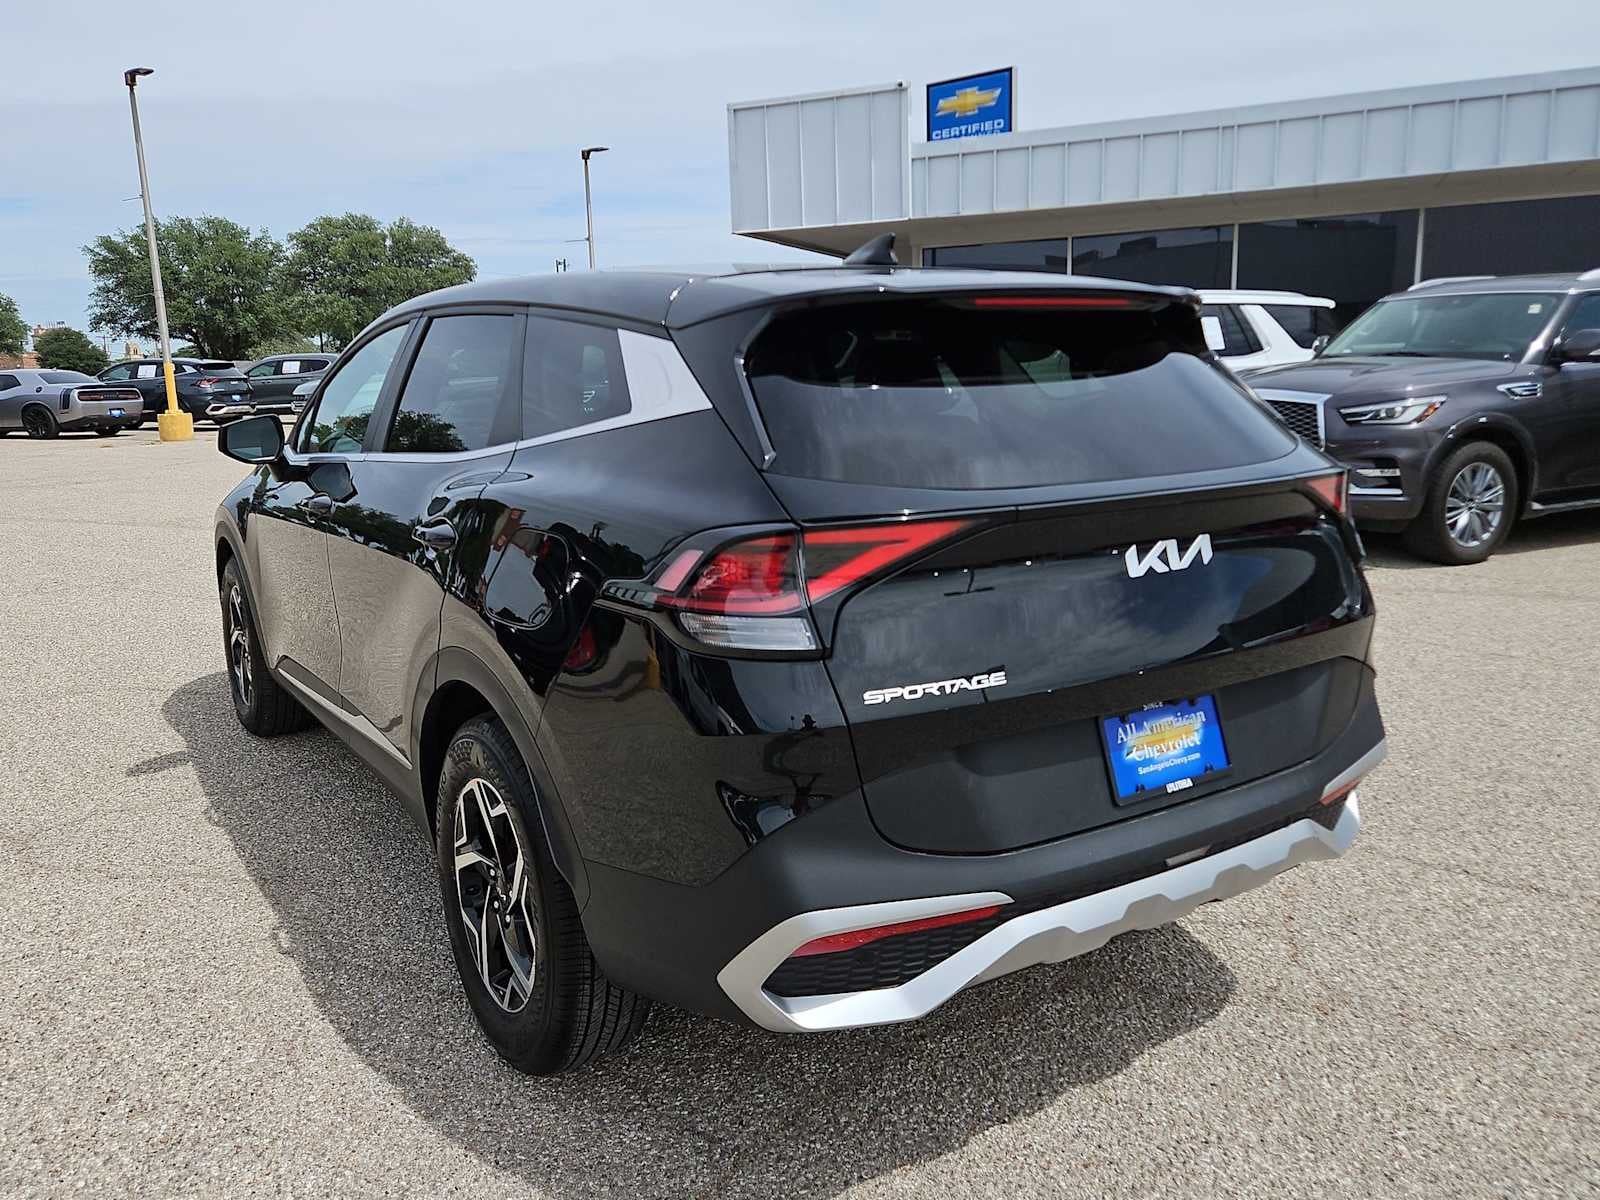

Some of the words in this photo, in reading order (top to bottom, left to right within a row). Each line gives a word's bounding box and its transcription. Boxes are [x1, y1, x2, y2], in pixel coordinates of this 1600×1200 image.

[932, 119, 1004, 140] CERTIFIED
[1125, 533, 1213, 578] KIA
[863, 671, 1008, 705] SPORTAGE
[1117, 721, 1136, 744] All
[1142, 710, 1207, 736] American
[1134, 730, 1202, 762] Chevrolet
